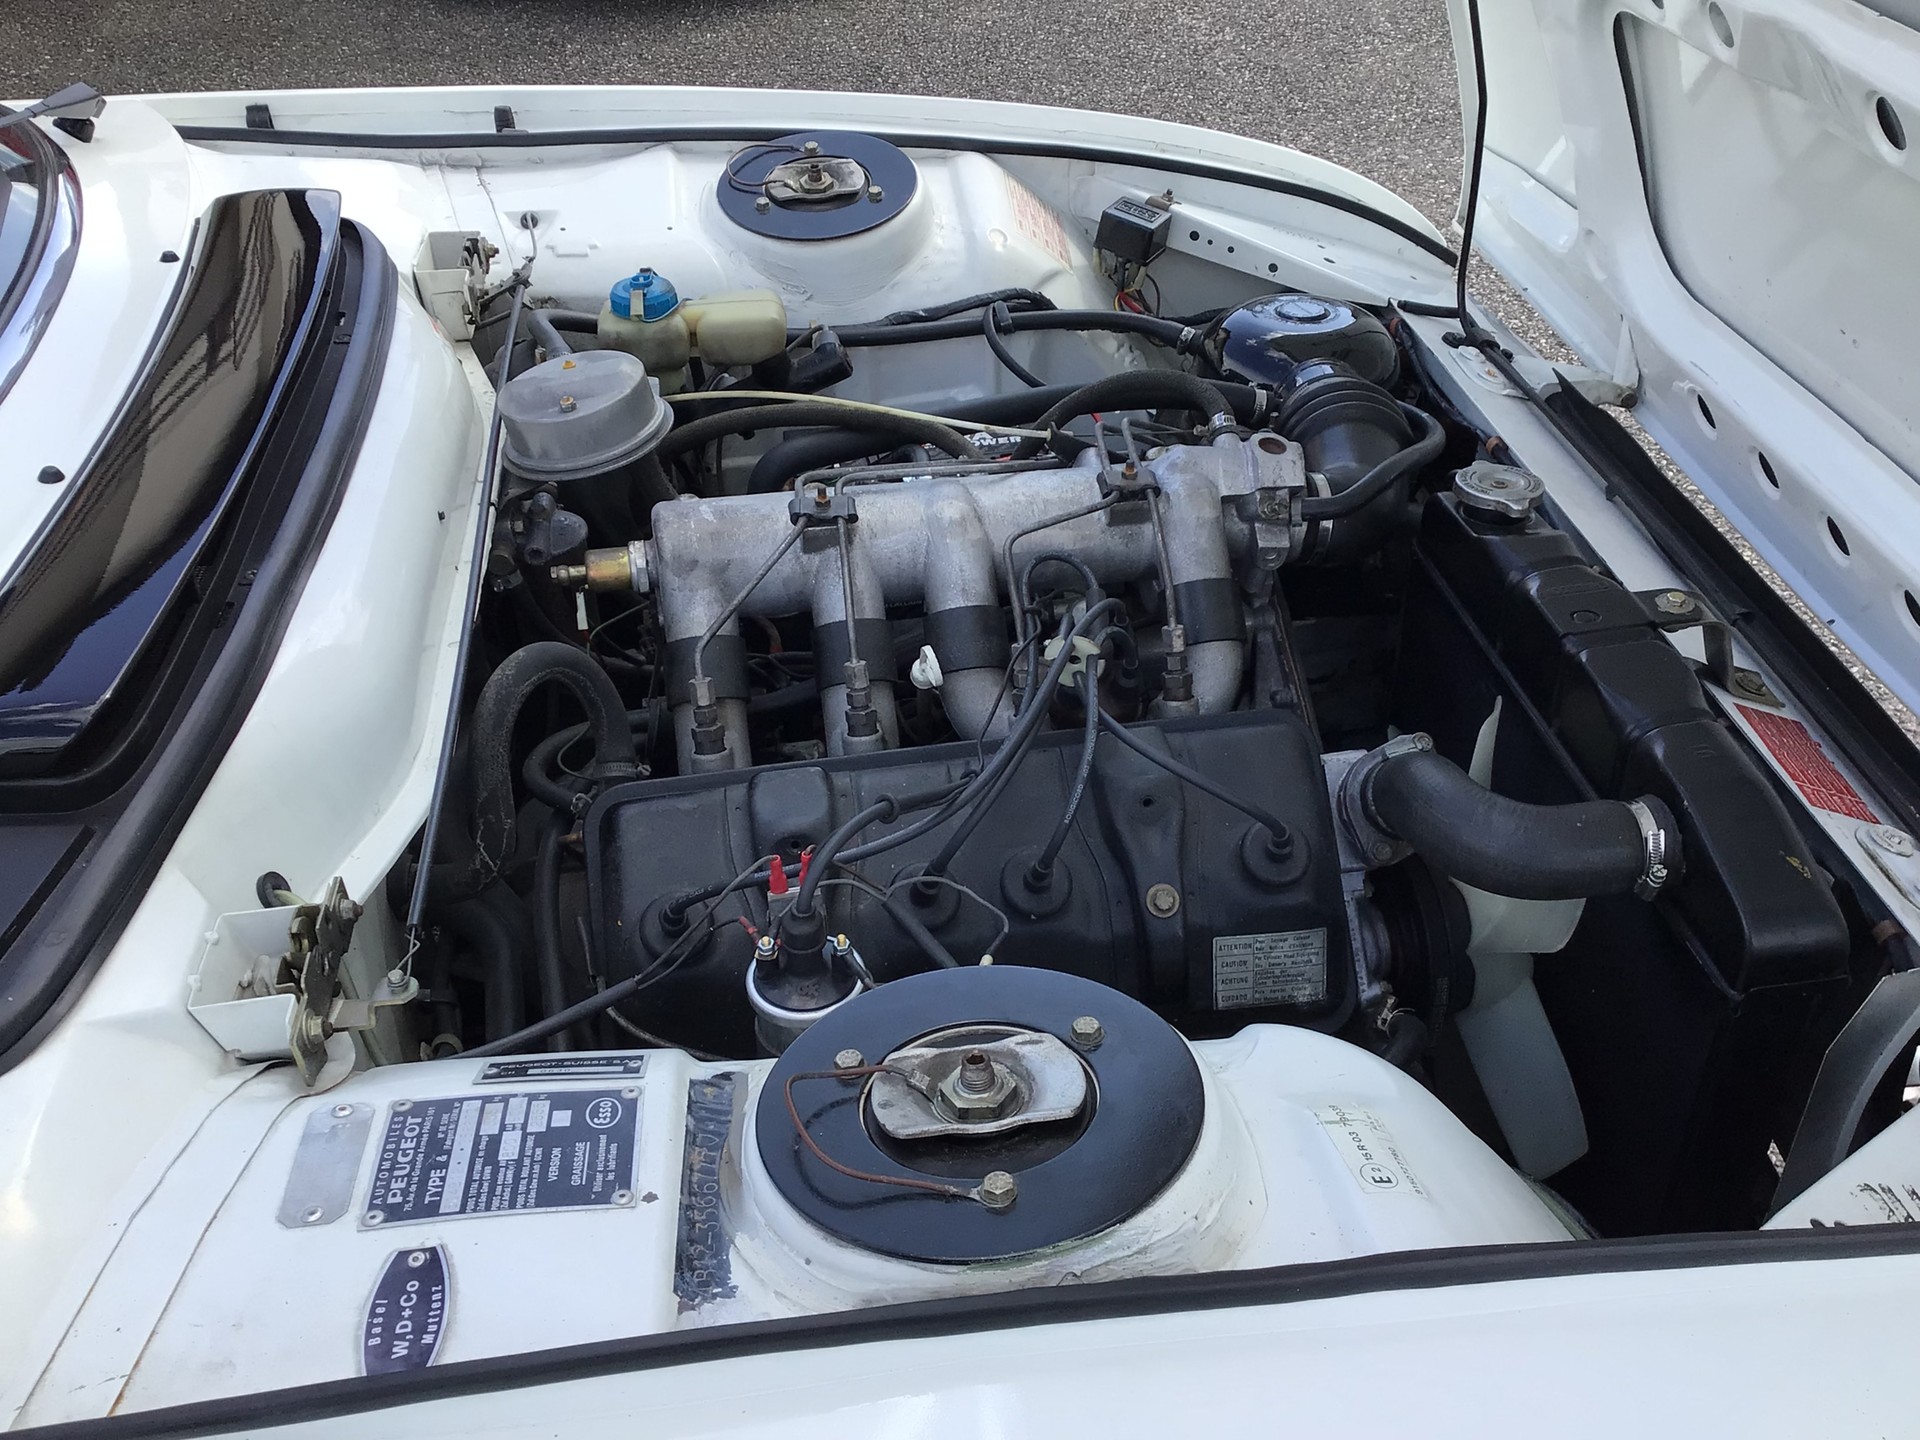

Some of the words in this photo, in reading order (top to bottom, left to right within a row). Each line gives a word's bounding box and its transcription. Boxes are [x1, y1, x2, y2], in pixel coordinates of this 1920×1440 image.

[1218, 942, 1252, 952] ATTENTION
[1221, 959, 1248, 969] CAUTION
[1220, 976, 1249, 986] ACHTUNG
[1221, 993, 1248, 1003] CUIDADO
[593, 1101, 612, 1124] Esso
[411, 1153, 424, 1177] Grande
[422, 1113, 434, 1134] PARIS
[596, 1134, 607, 1171] exclusivement
[372, 1116, 404, 1205] AUTOMOBILES
[386, 1115, 422, 1204] PEUGEOT
[435, 1154, 448, 1162] &
[547, 1147, 562, 1182] VERSION
[570, 1141, 586, 1186] GRAISSAGE
[606, 1143, 618, 1171] lubrifiants
[520, 1156, 532, 1178] ROULANT
[605, 1171, 616, 1181] les
[424, 1168, 447, 1204] TYPE
[518, 1178, 529, 1194] TOTAL
[592, 1172, 603, 1192] Utiliser
[1371, 1175, 1393, 1184] E
[468, 1181, 480, 1197] TOTAL
[494, 1184, 503, 1195] max
[465, 1197, 477, 1213] POIDS
[490, 1195, 501, 1211] POIDS
[515, 1193, 526, 1208] POIDS
[367, 1299, 388, 1347] Basel
[420, 1284, 442, 1344] Muttenz
